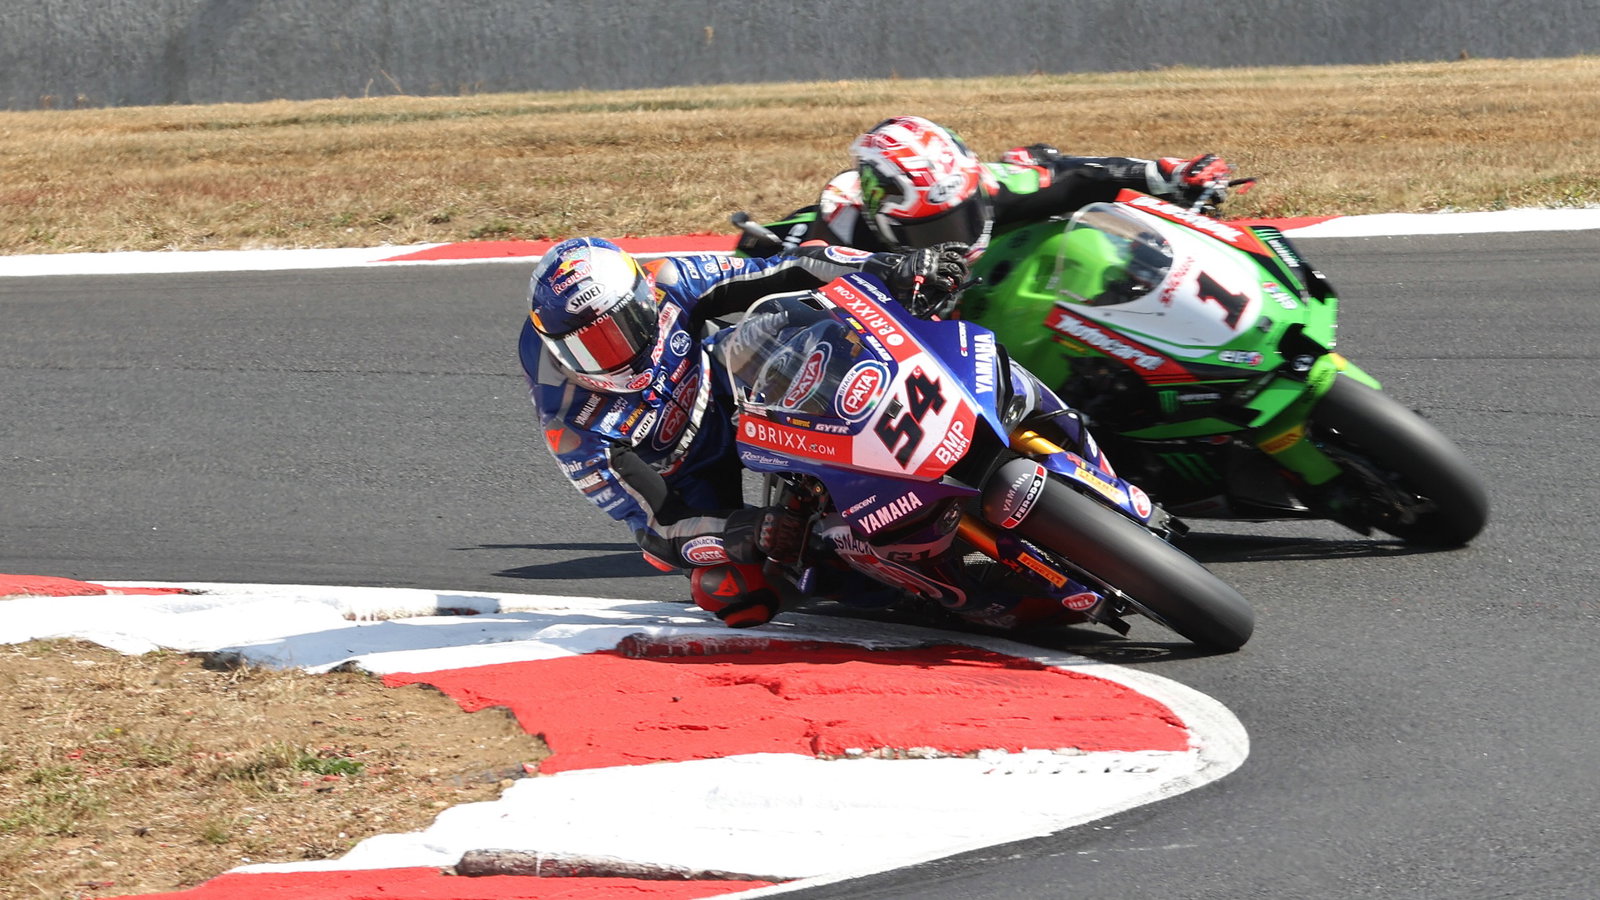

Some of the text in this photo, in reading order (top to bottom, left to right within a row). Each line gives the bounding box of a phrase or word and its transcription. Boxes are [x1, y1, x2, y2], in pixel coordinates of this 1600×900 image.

[552, 273, 575, 296] Red
[570, 285, 601, 310] SHOEI
[1196, 270, 1251, 331] 1
[591, 312, 610, 327] YOU
[789, 360, 819, 401] PATA
[974, 333, 994, 395] YAMAHA
[840, 370, 857, 396] SNACK
[846, 374, 877, 409] PATA
[574, 393, 602, 426] YAMALUBE
[874, 366, 948, 471] 54
[634, 415, 655, 443] SHOEI
[814, 423, 850, 434] GYTR
[935, 420, 965, 465] BMP
[950, 436, 970, 463] TAPPI
[841, 494, 877, 518] CRESCENT
[1002, 472, 1031, 512] YAMAHA
[1015, 478, 1042, 519] FERODO
[858, 490, 924, 534] YAMAHA
[691, 550, 727, 562] PATA
